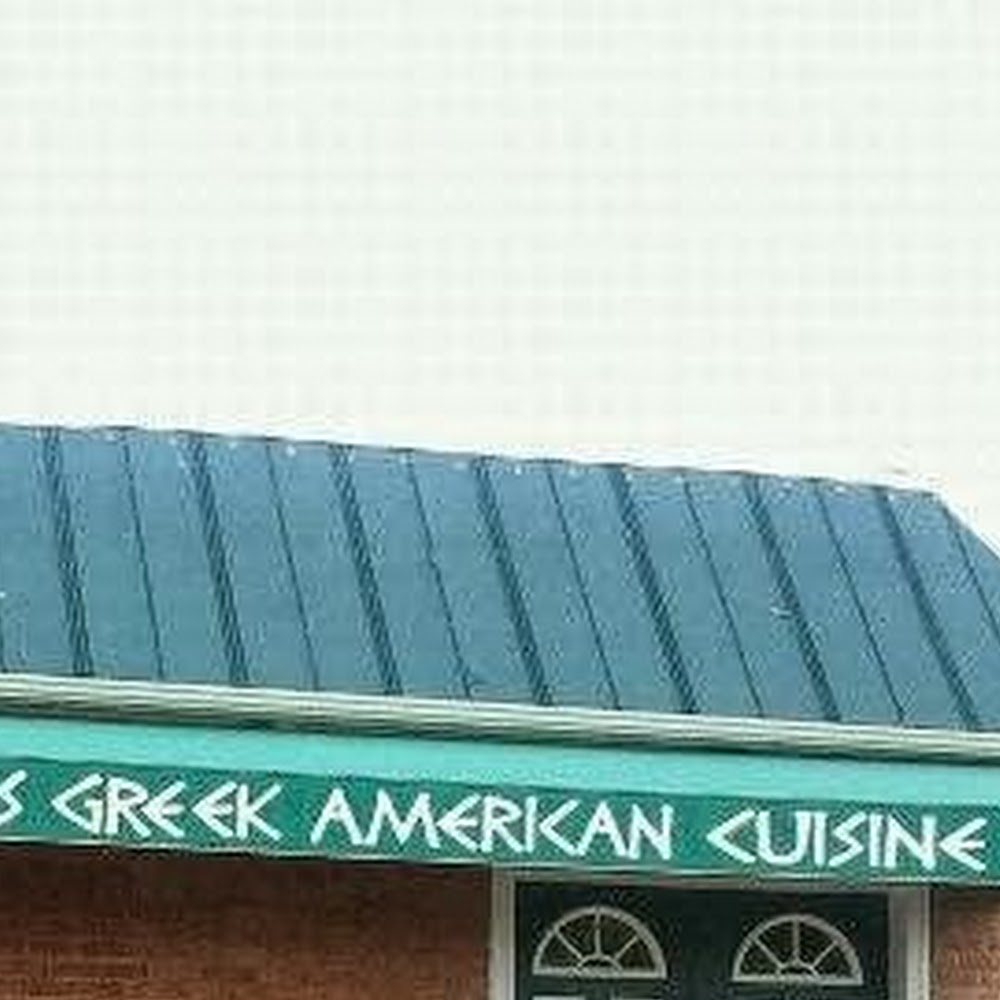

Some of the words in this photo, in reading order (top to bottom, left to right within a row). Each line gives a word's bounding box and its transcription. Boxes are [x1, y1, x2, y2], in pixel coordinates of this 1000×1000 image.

[50, 772, 281, 841] GREEK
[309, 787, 674, 861] AMERICAN
[706, 807, 988, 872] CUISINE
